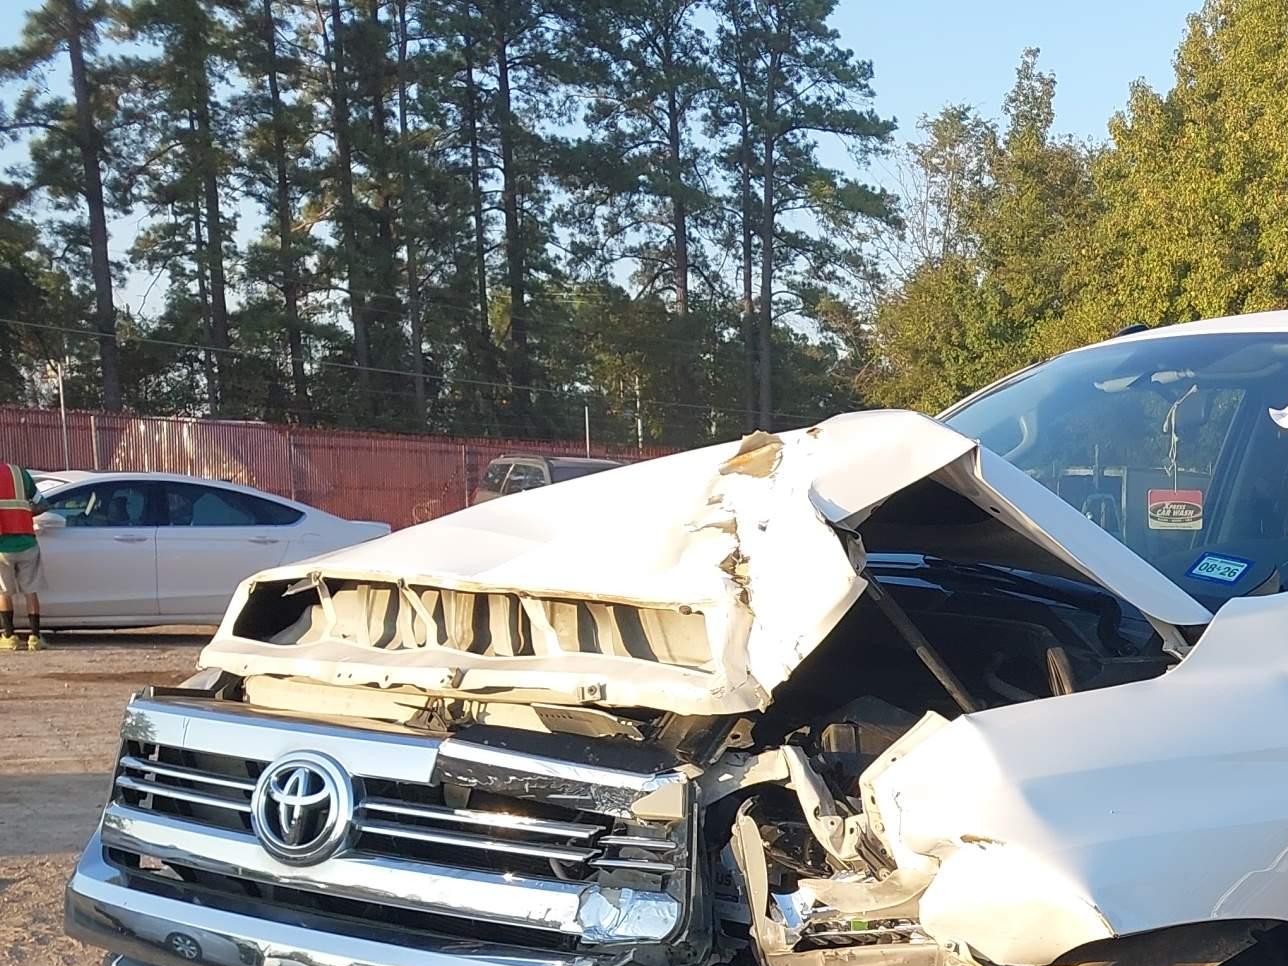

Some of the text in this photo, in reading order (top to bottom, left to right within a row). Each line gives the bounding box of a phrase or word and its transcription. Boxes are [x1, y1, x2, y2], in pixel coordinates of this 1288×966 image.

[1156, 509, 1194, 518] CAR WASH
[1198, 562, 1218, 573] 08
[1219, 566, 1240, 578] 26
